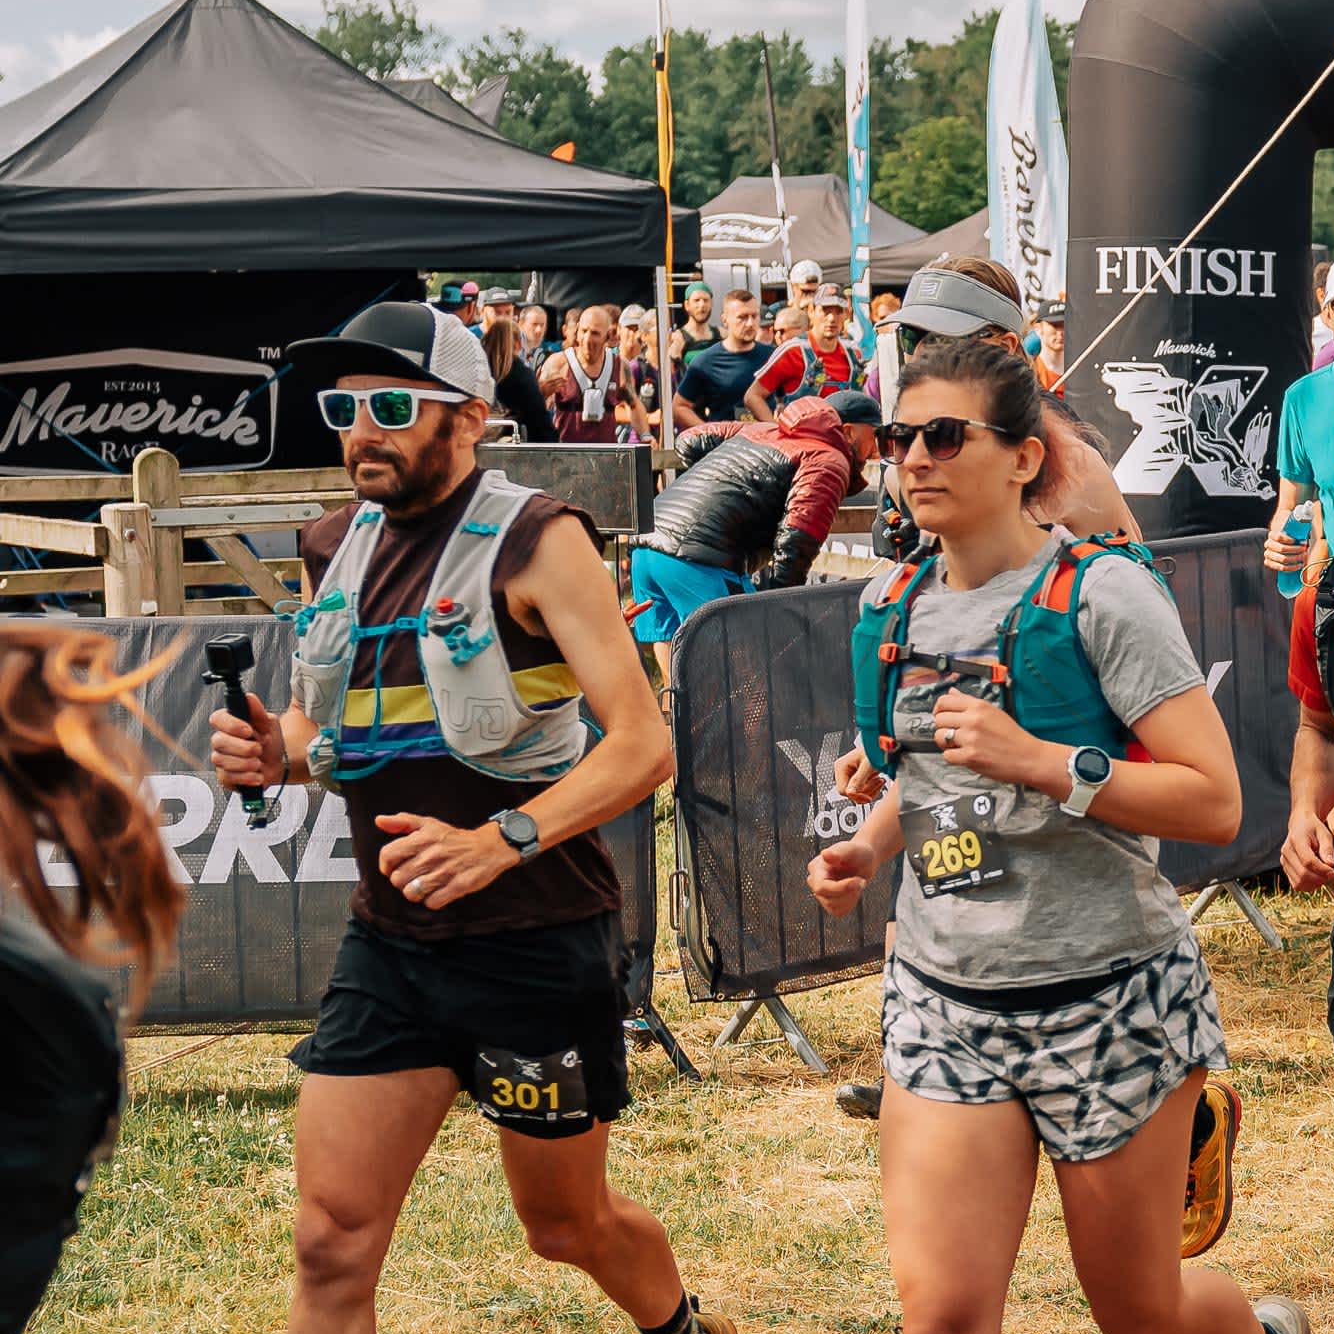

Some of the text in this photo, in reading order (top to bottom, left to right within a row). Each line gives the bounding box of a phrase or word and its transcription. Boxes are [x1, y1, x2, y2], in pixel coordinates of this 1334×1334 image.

[1095, 246, 1277, 297] FINISH
[258, 347, 281, 359] TM
[1153, 339, 1217, 359] Maverick
[0, 382, 259, 452] Maverick
[36, 774, 361, 887] RRE
[922, 830, 982, 879] 269
[492, 1077, 559, 1110] 301
